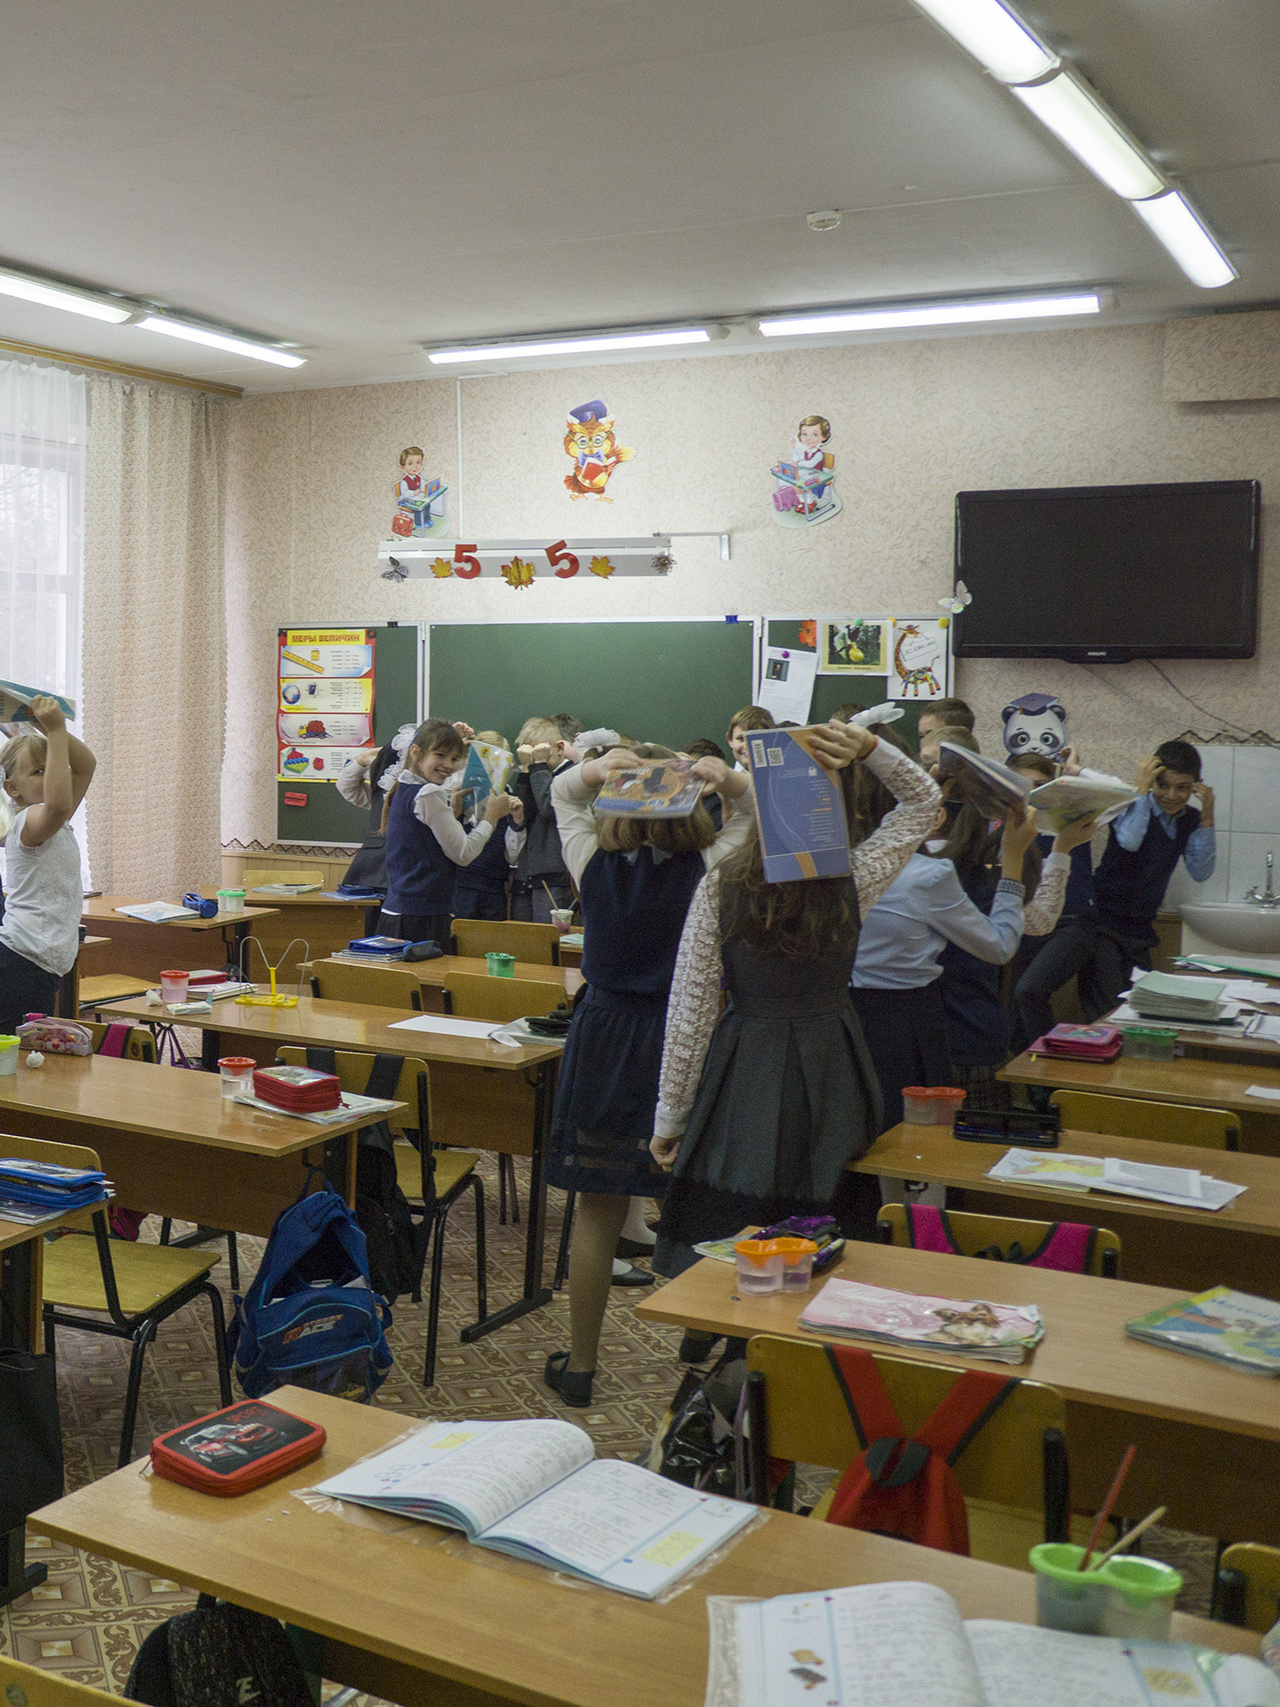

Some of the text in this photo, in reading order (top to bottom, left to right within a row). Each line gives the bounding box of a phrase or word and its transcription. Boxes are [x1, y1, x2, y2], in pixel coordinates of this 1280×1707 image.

[454, 540, 580, 579] 5 5
[291, 634, 360, 643] МЕРЫ ВЕЛИЧИН
